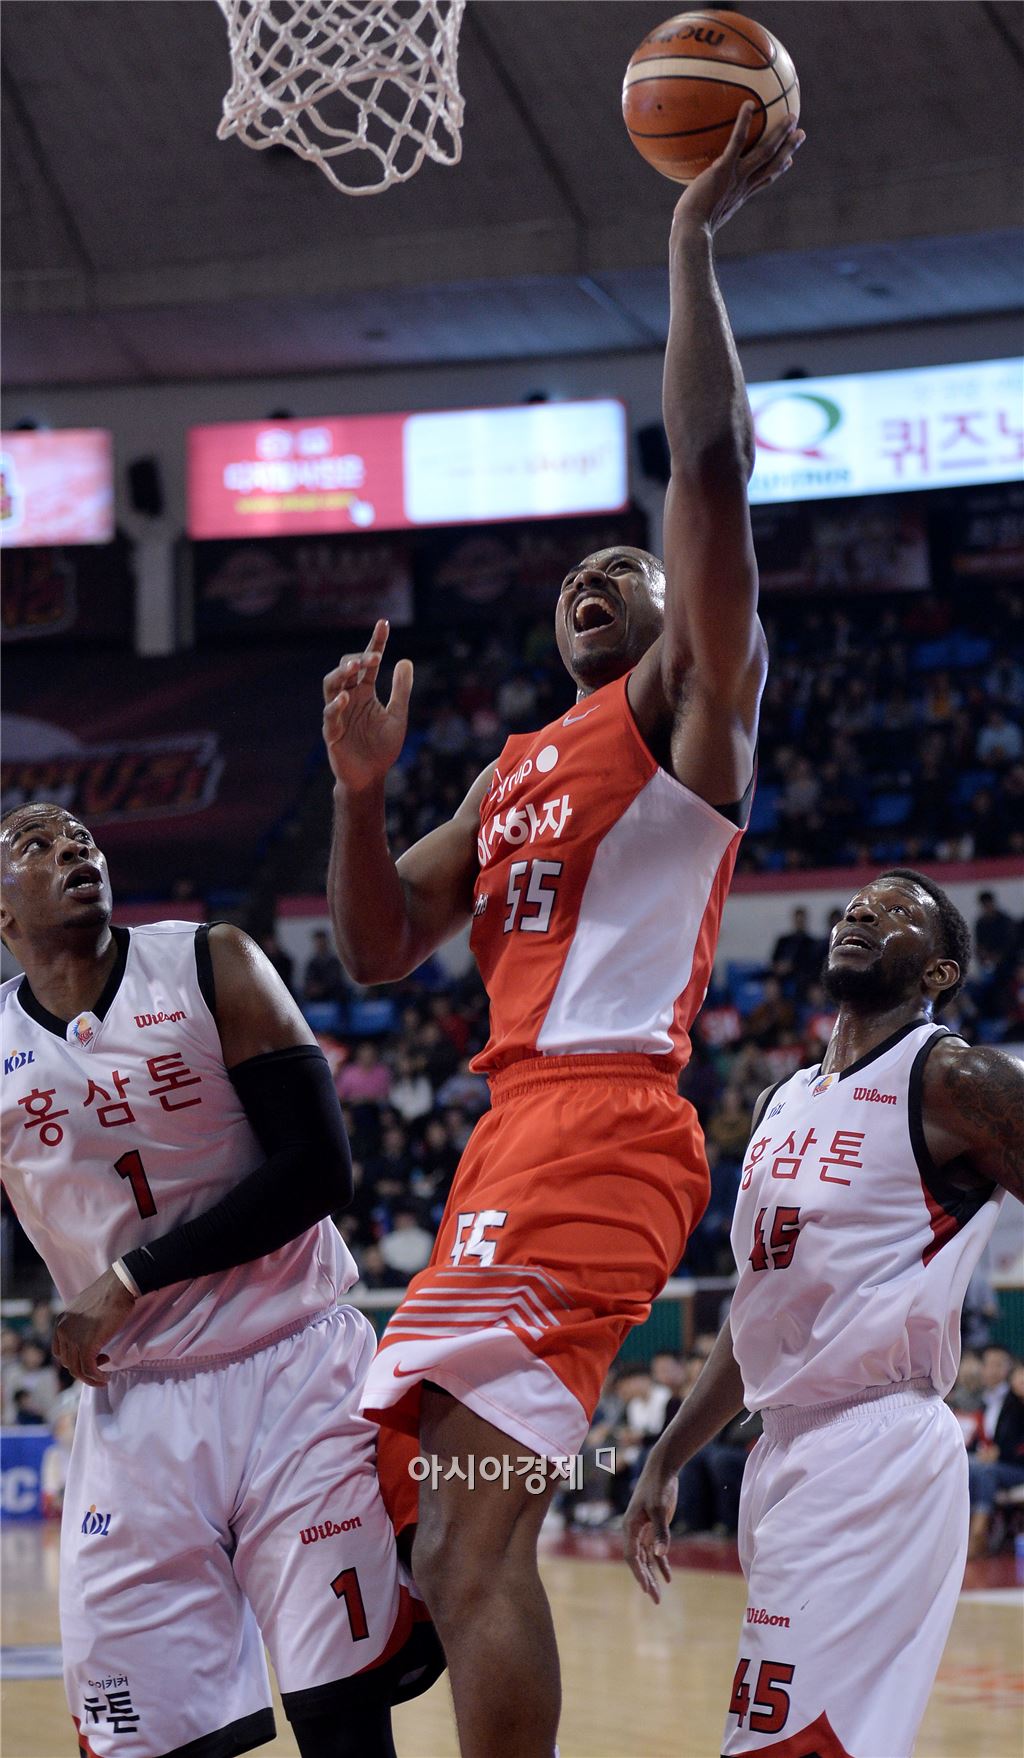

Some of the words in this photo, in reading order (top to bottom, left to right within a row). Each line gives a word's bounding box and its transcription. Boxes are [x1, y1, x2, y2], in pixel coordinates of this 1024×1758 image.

[503, 858, 563, 934] 55
[134, 1010, 187, 1029] Wilson
[18, 1052, 202, 1147] 홍삼톤
[853, 1087, 897, 1105] Wilson
[113, 1149, 158, 1220] 1
[741, 1127, 866, 1191] 홍삼톤
[300, 1515, 362, 1545] Wilson
[330, 1566, 370, 1643] 1
[728, 1658, 796, 1735] 45
